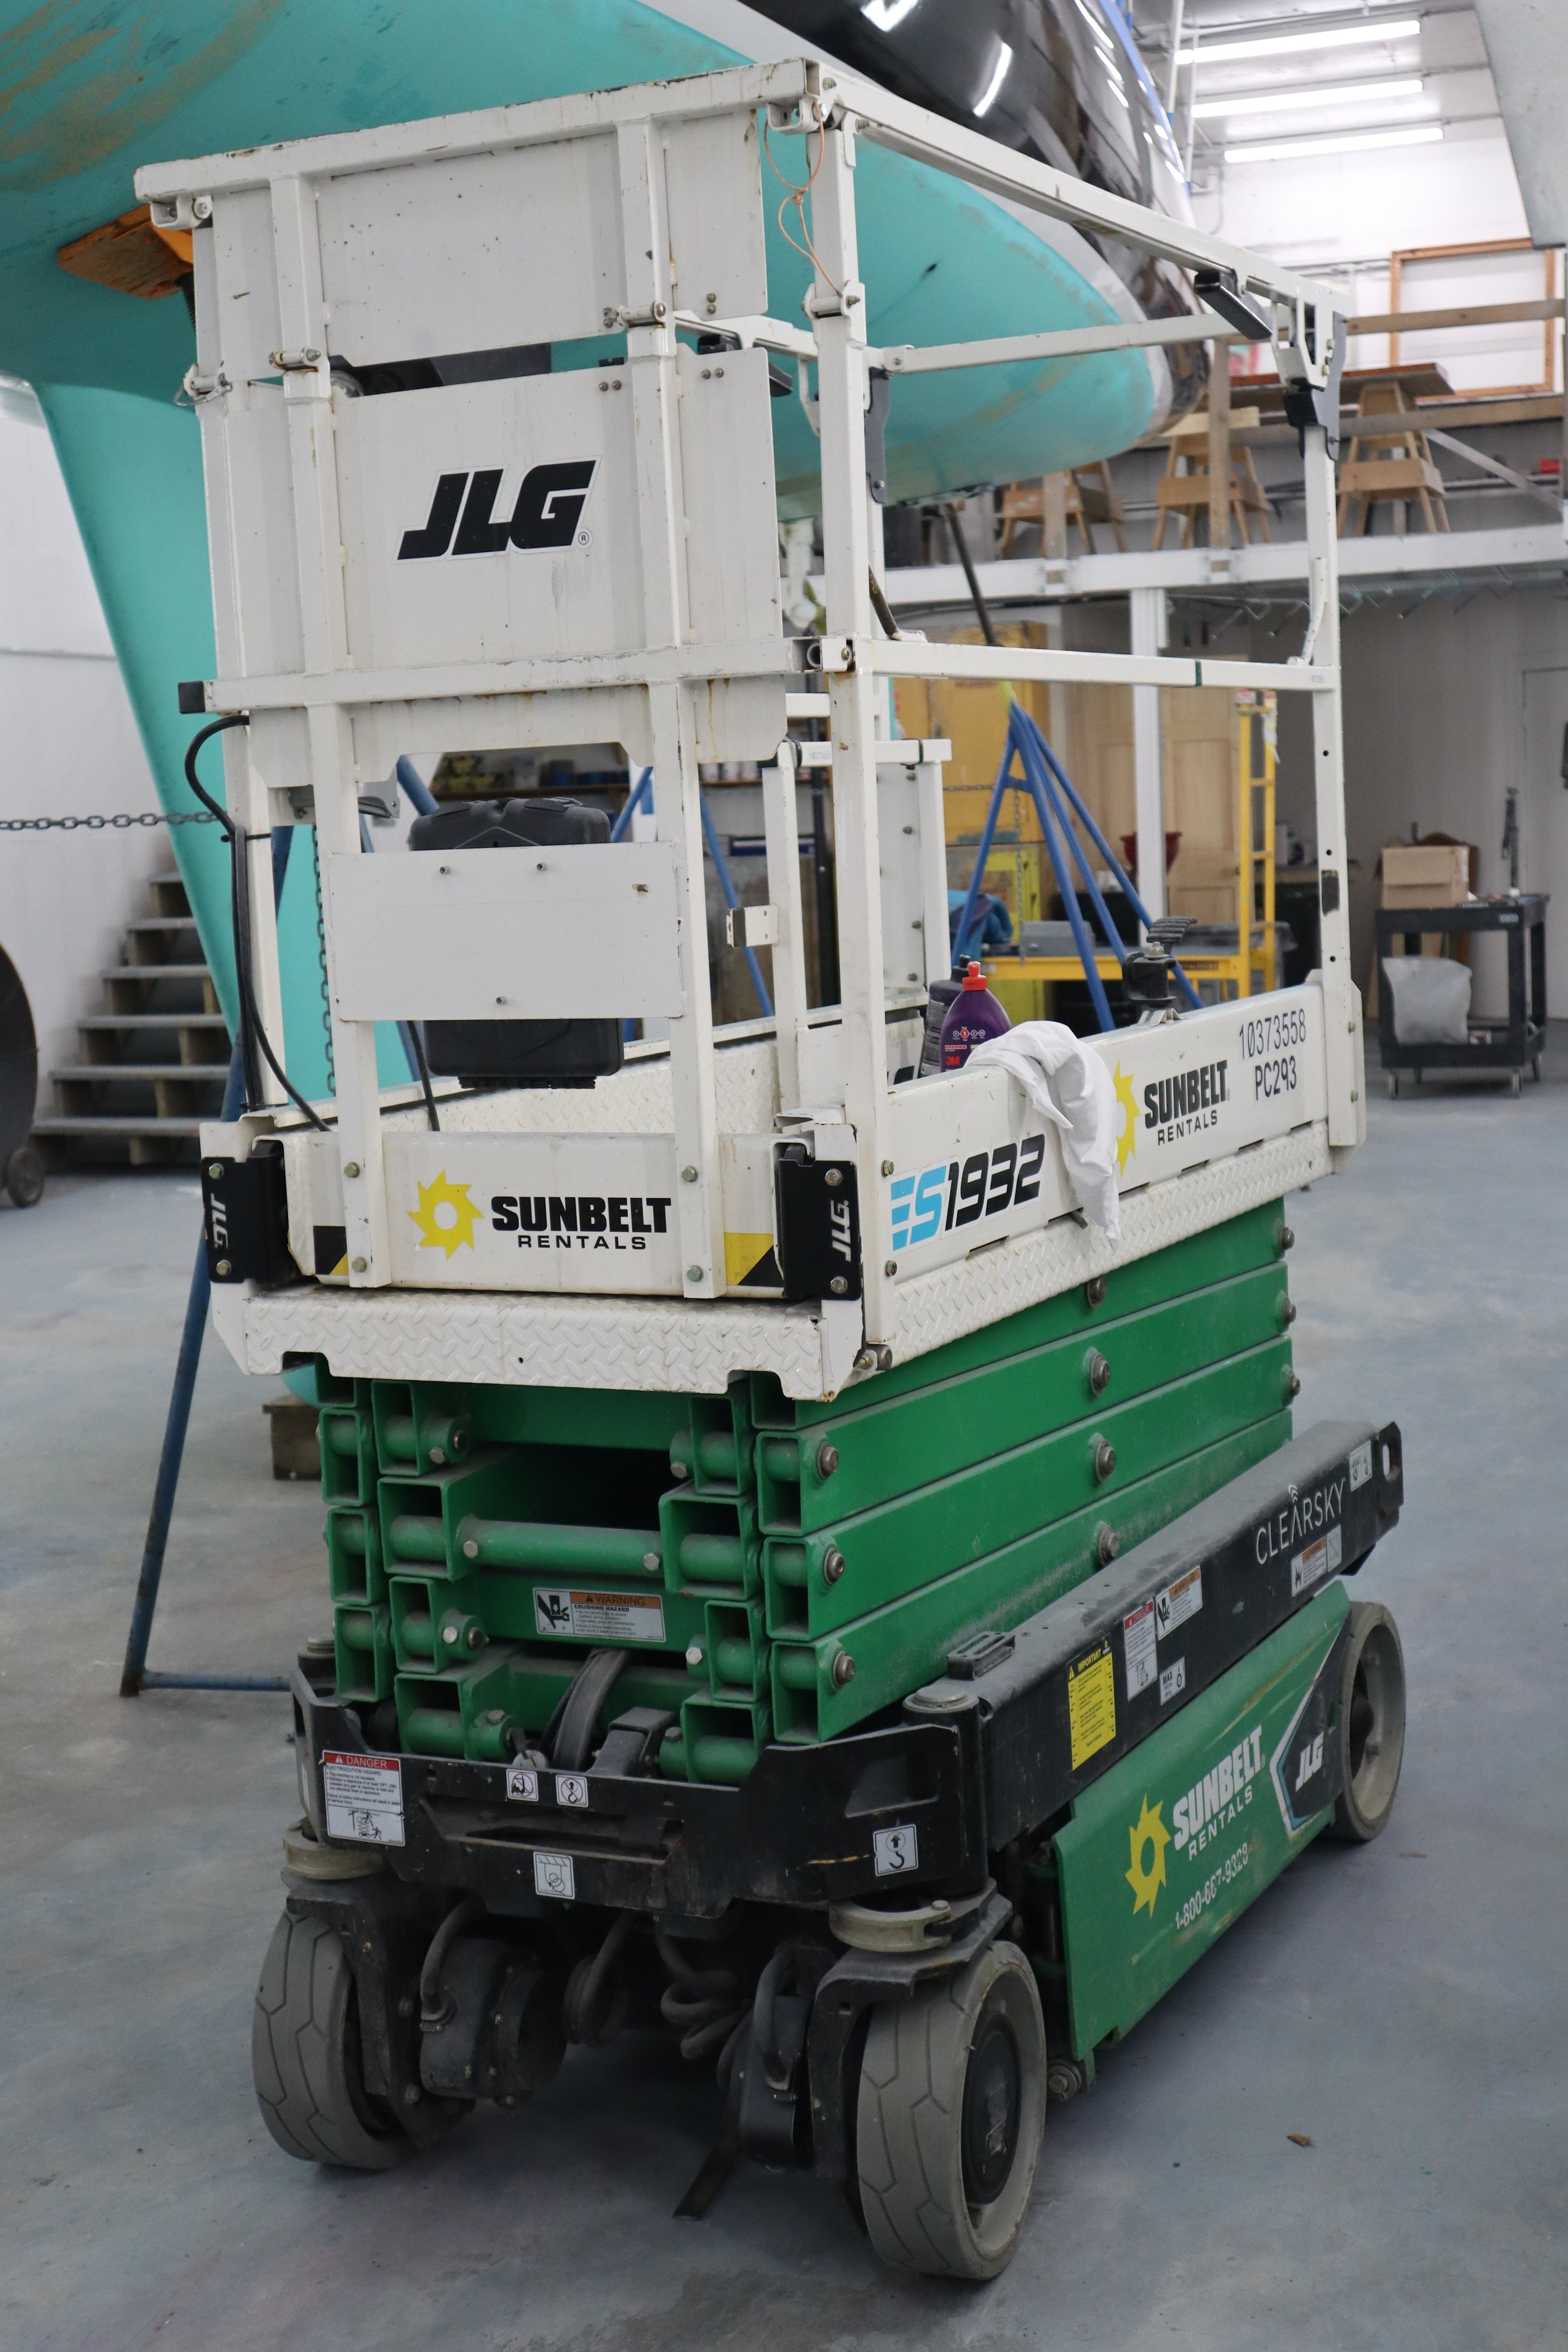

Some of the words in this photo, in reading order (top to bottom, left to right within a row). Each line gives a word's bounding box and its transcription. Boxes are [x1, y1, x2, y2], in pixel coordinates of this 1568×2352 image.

[397, 460, 596, 561] JLG
[1239, 1008, 1306, 1060] 10373558
[946, 1056, 960, 1065] 3M
[1254, 1055, 1297, 1101] PC293
[1144, 1059, 1228, 1129] SUNBELT
[1157, 1109, 1218, 1146] RENTALS
[210, 1192, 228, 1249] JLG
[490, 1196, 672, 1233] SUNBELT
[830, 1199, 852, 1263] JLG
[517, 1235, 646, 1249] RENTALS
[1256, 1477, 1347, 1565] CLEARSKY
[595, 1595, 645, 1607] WARNING
[1078, 1648, 1102, 1672] IMPORTANT
[1163, 1670, 1173, 1685] MAX
[346, 1756, 387, 1769] DANGER
[1295, 1731, 1325, 1793] JLG
[1172, 1724, 1263, 1851] SUNBELT
[1189, 1785, 1253, 1862] RENTALS
